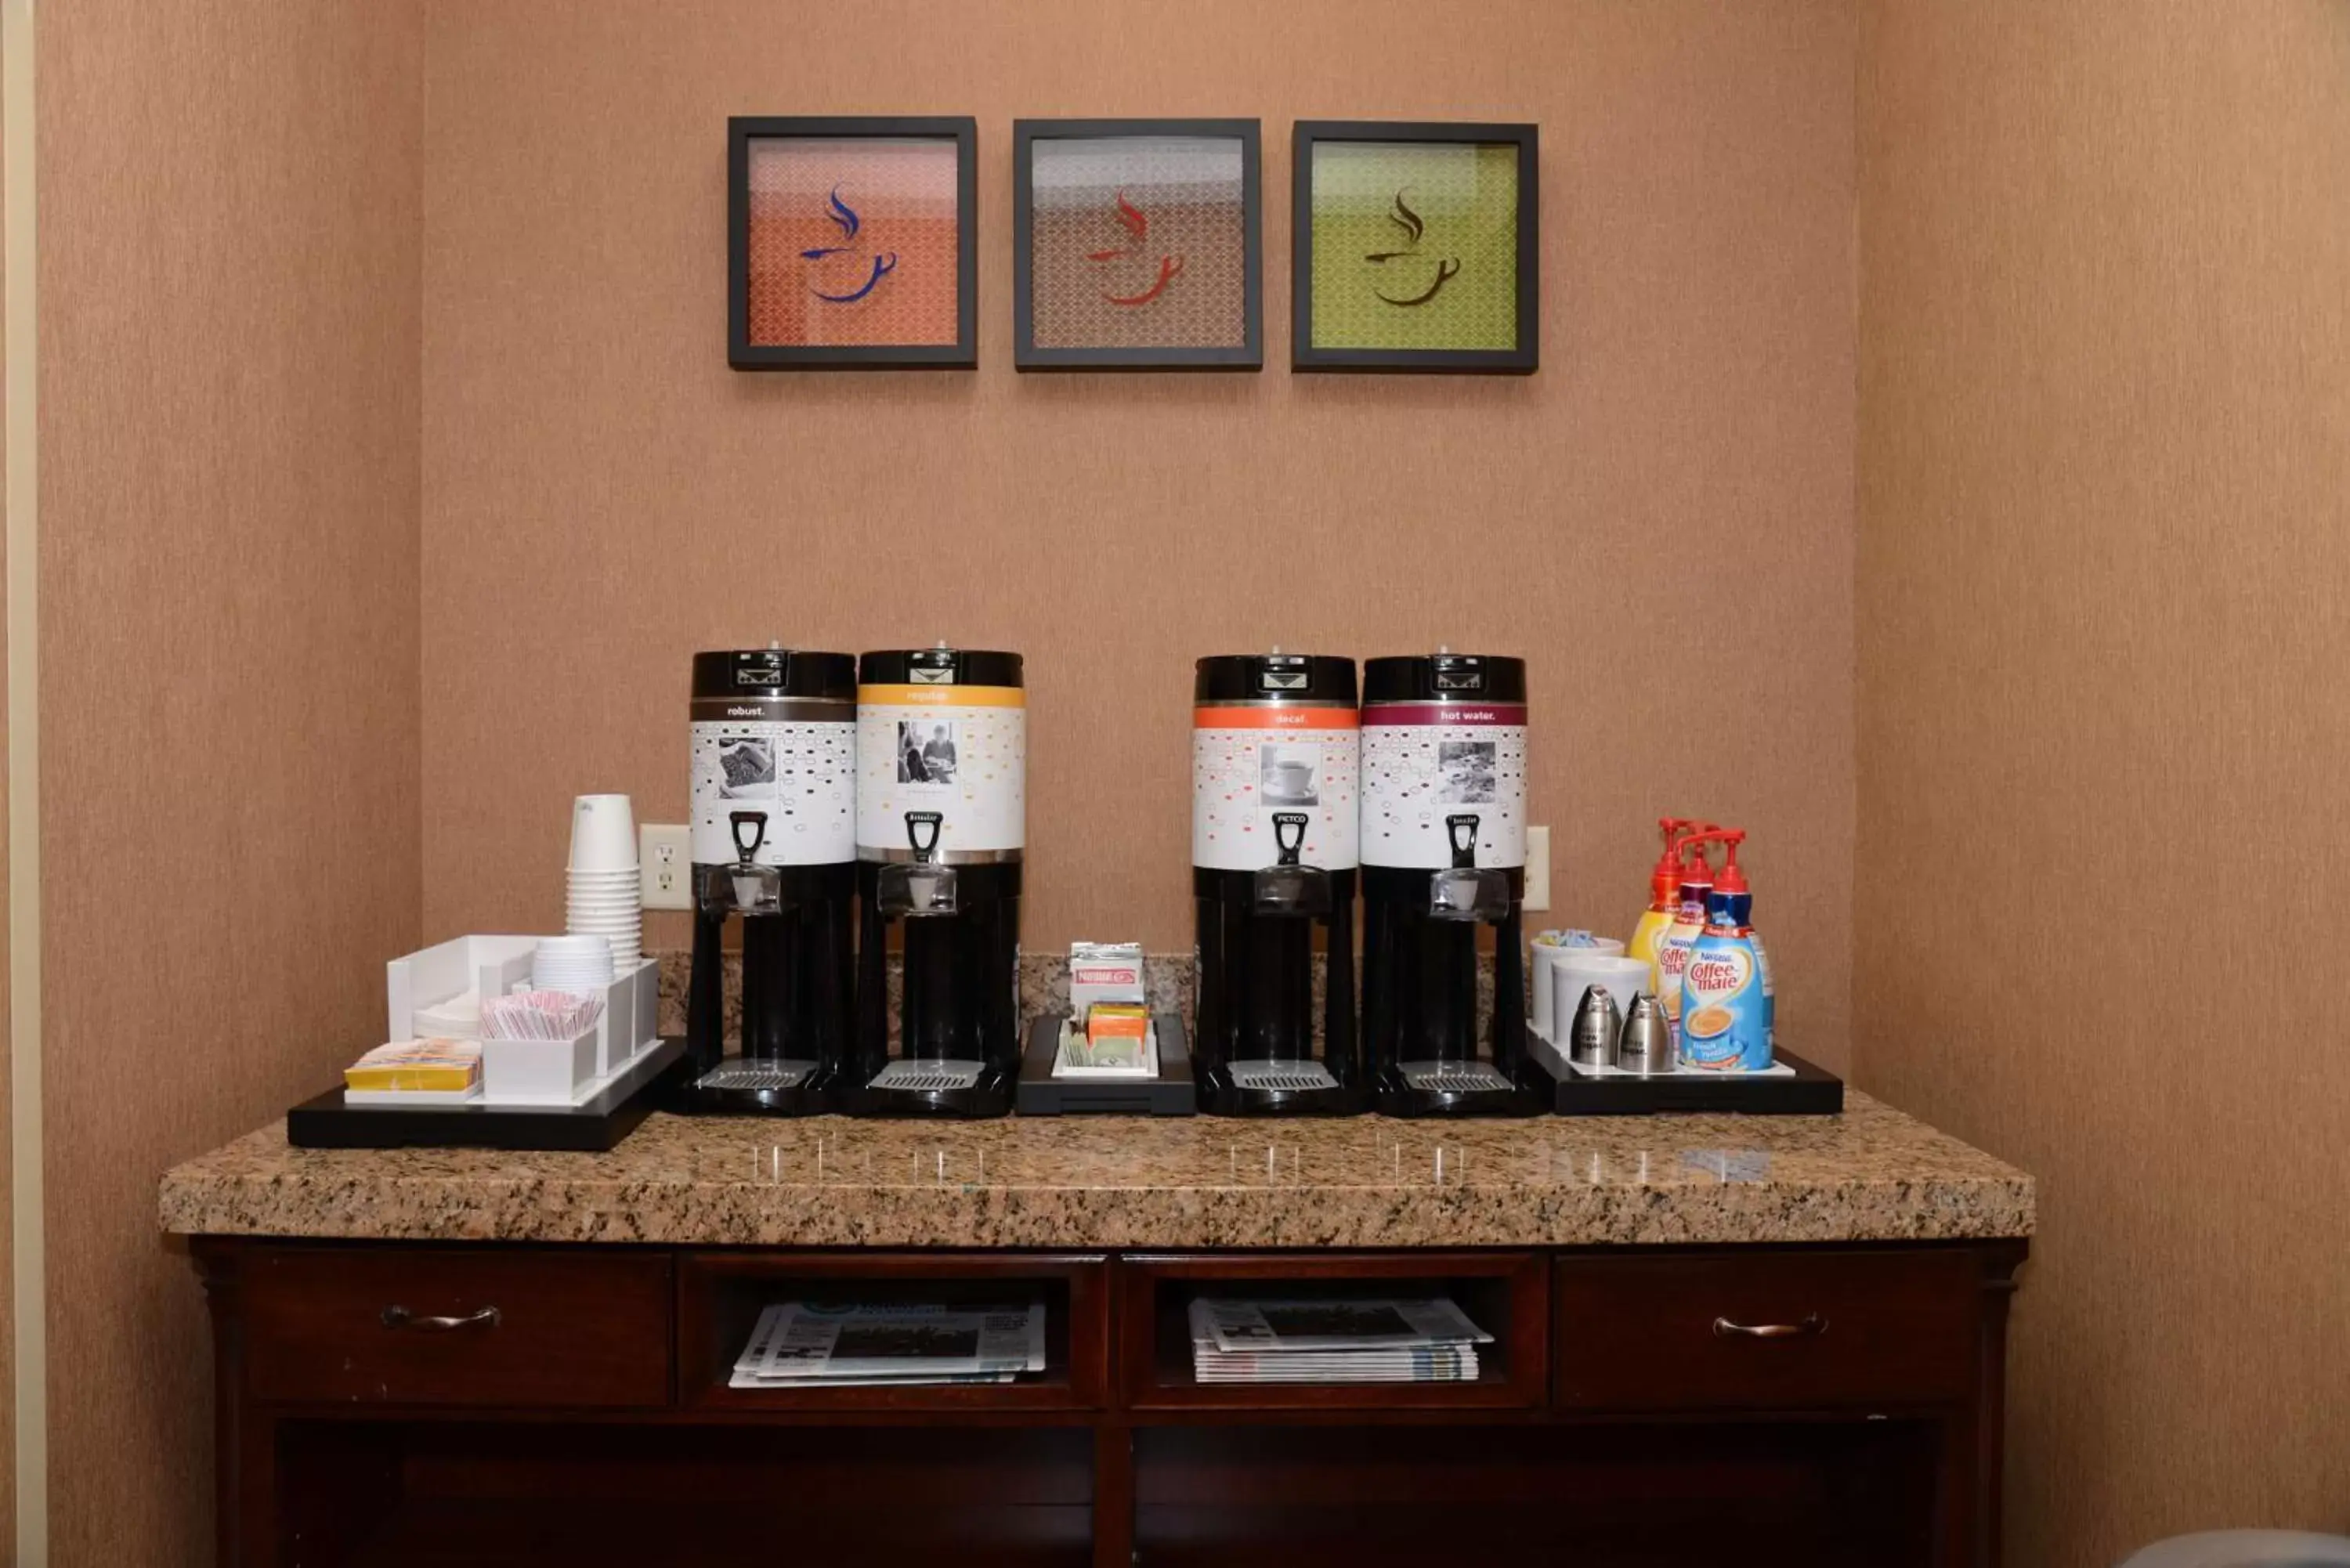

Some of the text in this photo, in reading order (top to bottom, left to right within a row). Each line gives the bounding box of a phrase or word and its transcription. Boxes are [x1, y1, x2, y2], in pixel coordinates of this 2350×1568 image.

[727, 706, 765, 716] robust.
[1441, 711, 1495, 721] hot water.
[1665, 964, 1684, 975] ma
[1698, 976, 1737, 991] mate
